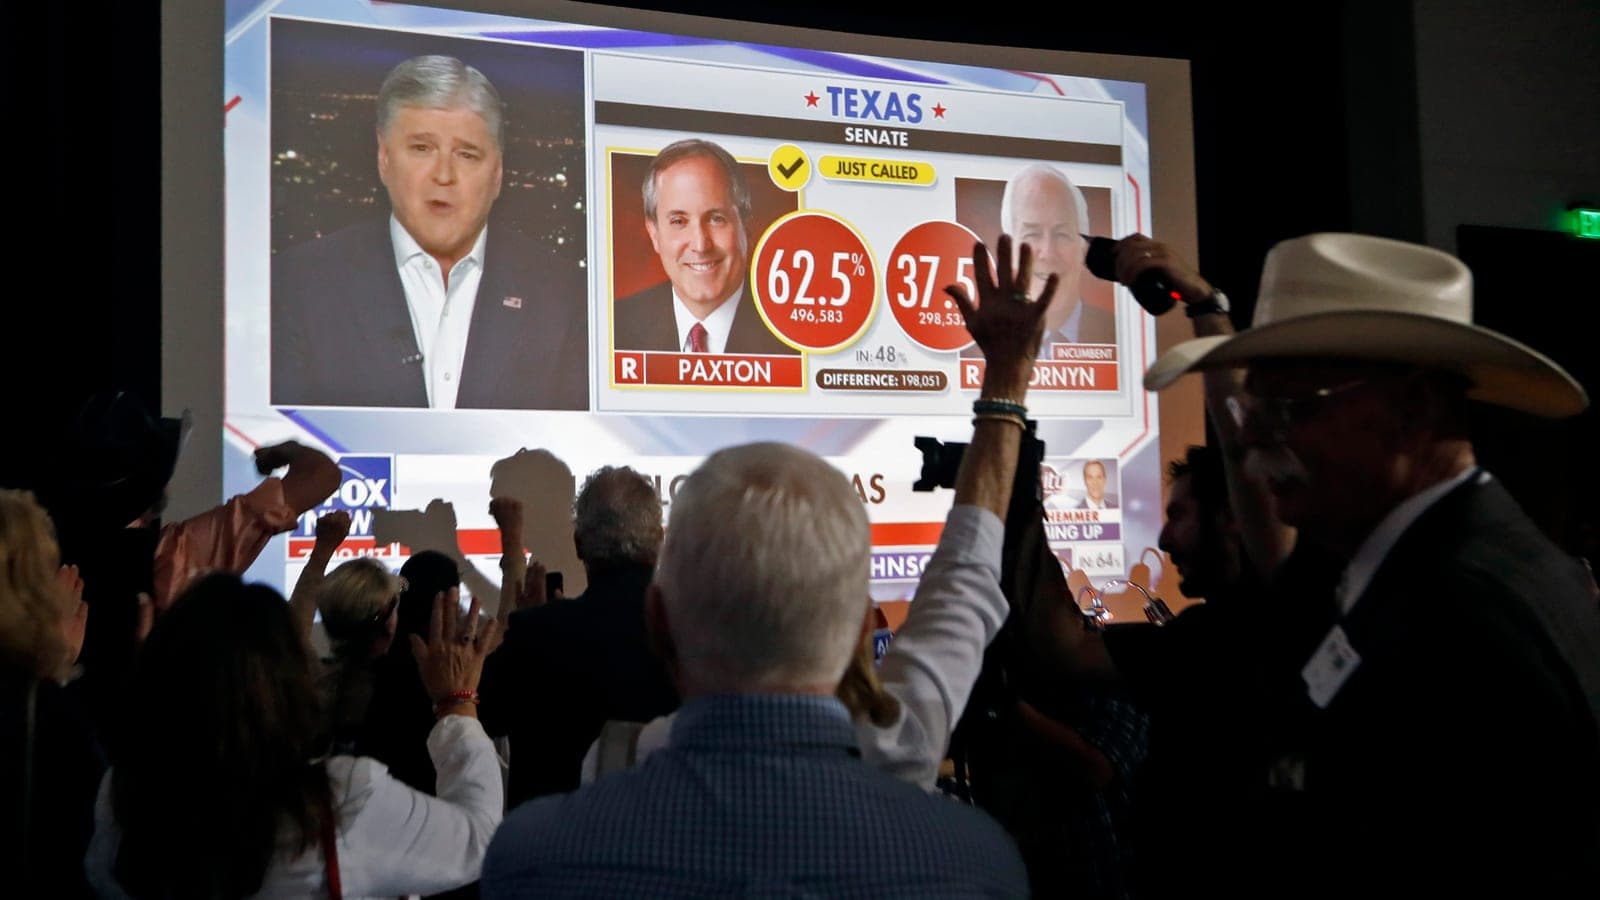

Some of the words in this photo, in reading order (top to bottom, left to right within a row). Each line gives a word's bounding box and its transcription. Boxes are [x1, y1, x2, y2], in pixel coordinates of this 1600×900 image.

[826, 86, 923, 124] TEXAS
[845, 127, 909, 147] SENATE
[835, 161, 867, 177] JUST
[871, 162, 918, 179] CALLED
[768, 249, 865, 306] 62.5%
[790, 309, 843, 323] 496,583
[855, 350, 873, 362] IN:
[1057, 347, 1113, 359] INCUMBENT
[621, 357, 638, 379] R
[679, 359, 771, 382] PAXTON
[966, 364, 980, 385] R
[1027, 366, 1096, 387] ORNYN
[823, 373, 899, 387] DIFFERENCE:
[902, 374, 940, 388] 198,051
[1083, 525, 1104, 539] UP
